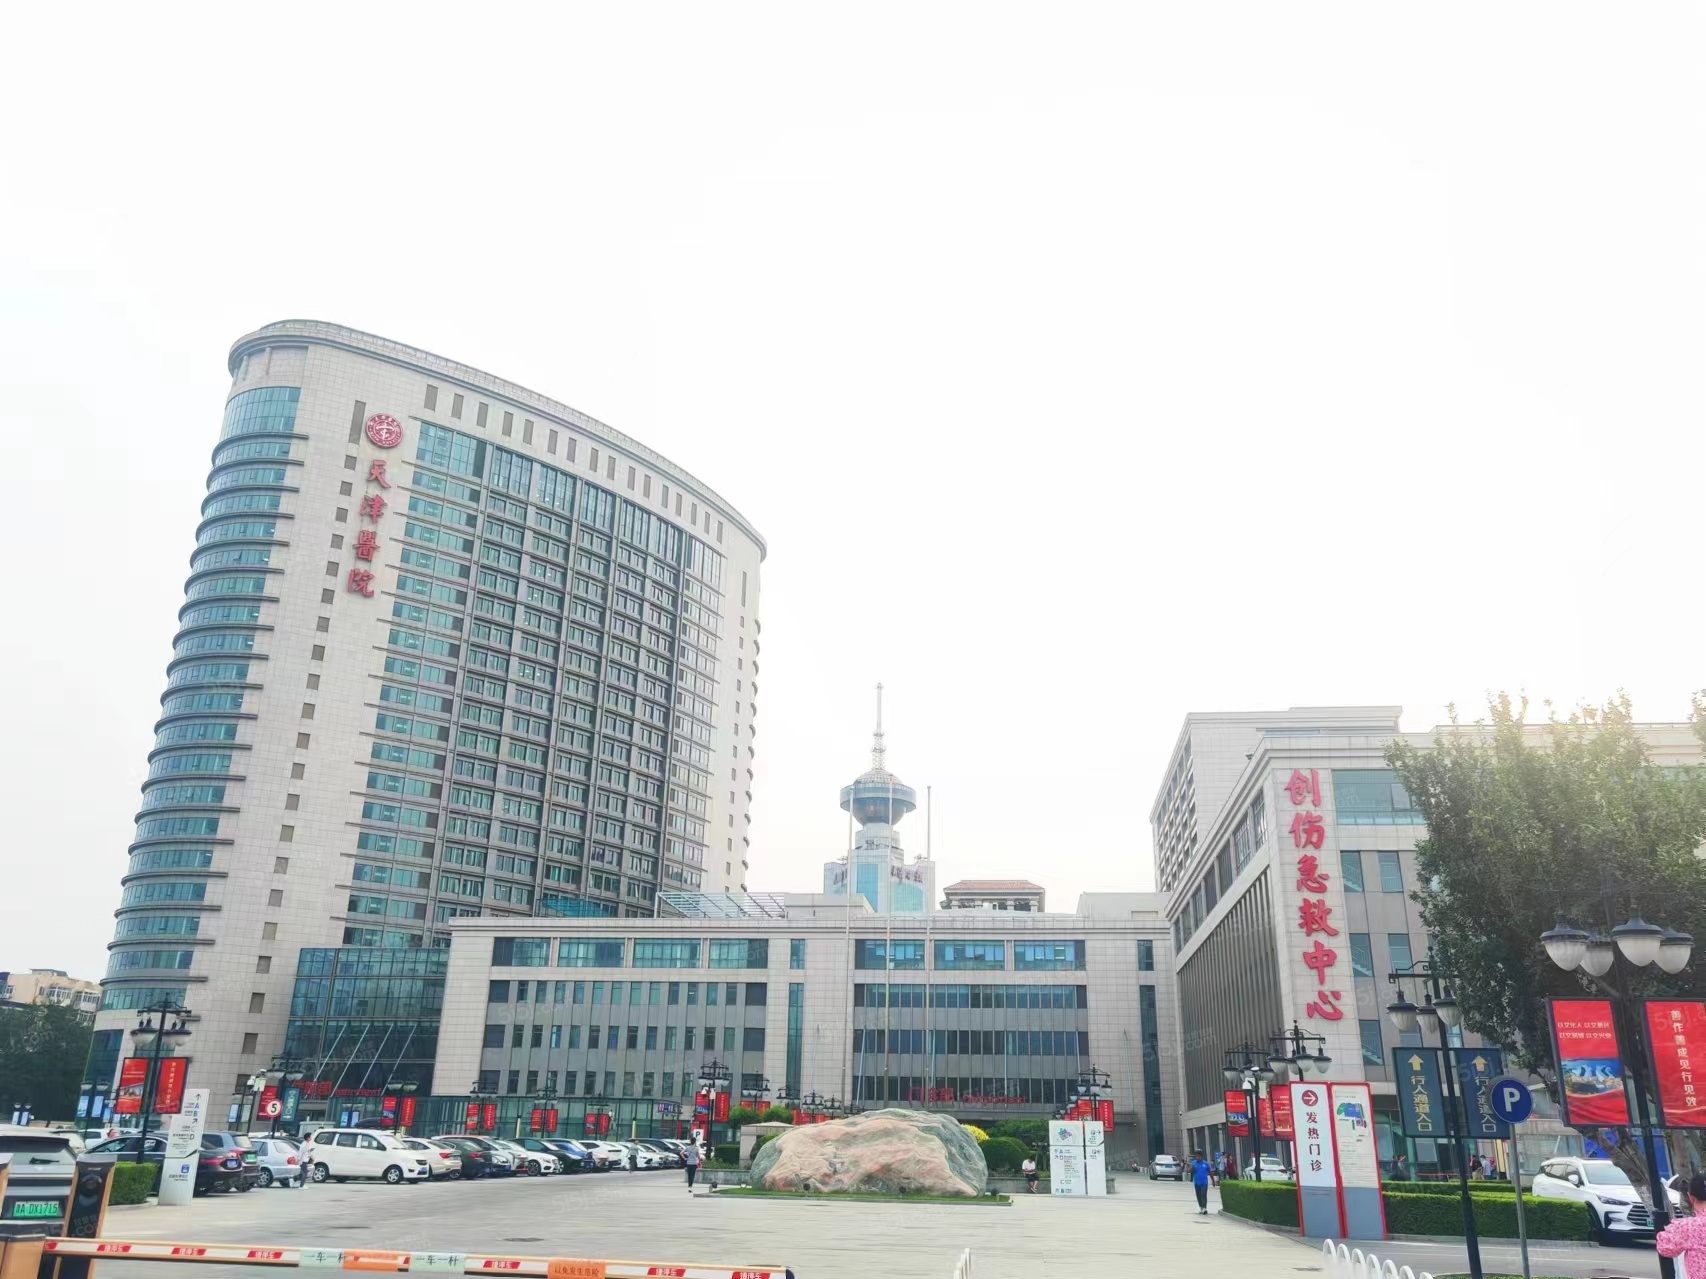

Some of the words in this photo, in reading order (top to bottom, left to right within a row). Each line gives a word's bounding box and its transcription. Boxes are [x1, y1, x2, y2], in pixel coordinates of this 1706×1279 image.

[348, 459, 391, 597] 天津醫院
[1284, 768, 1344, 1021] 创伤急救中心
[1671, 1010, 1697, 1107] 善作善成见行见效
[271, 1103, 277, 1113] 5
[1411, 1076, 1432, 1131] 行人通道入口
[1503, 1087, 1520, 1112] P
[1306, 1111, 1322, 1172] 发热门诊
[415, 1255, 460, 1266] 一车一杆
